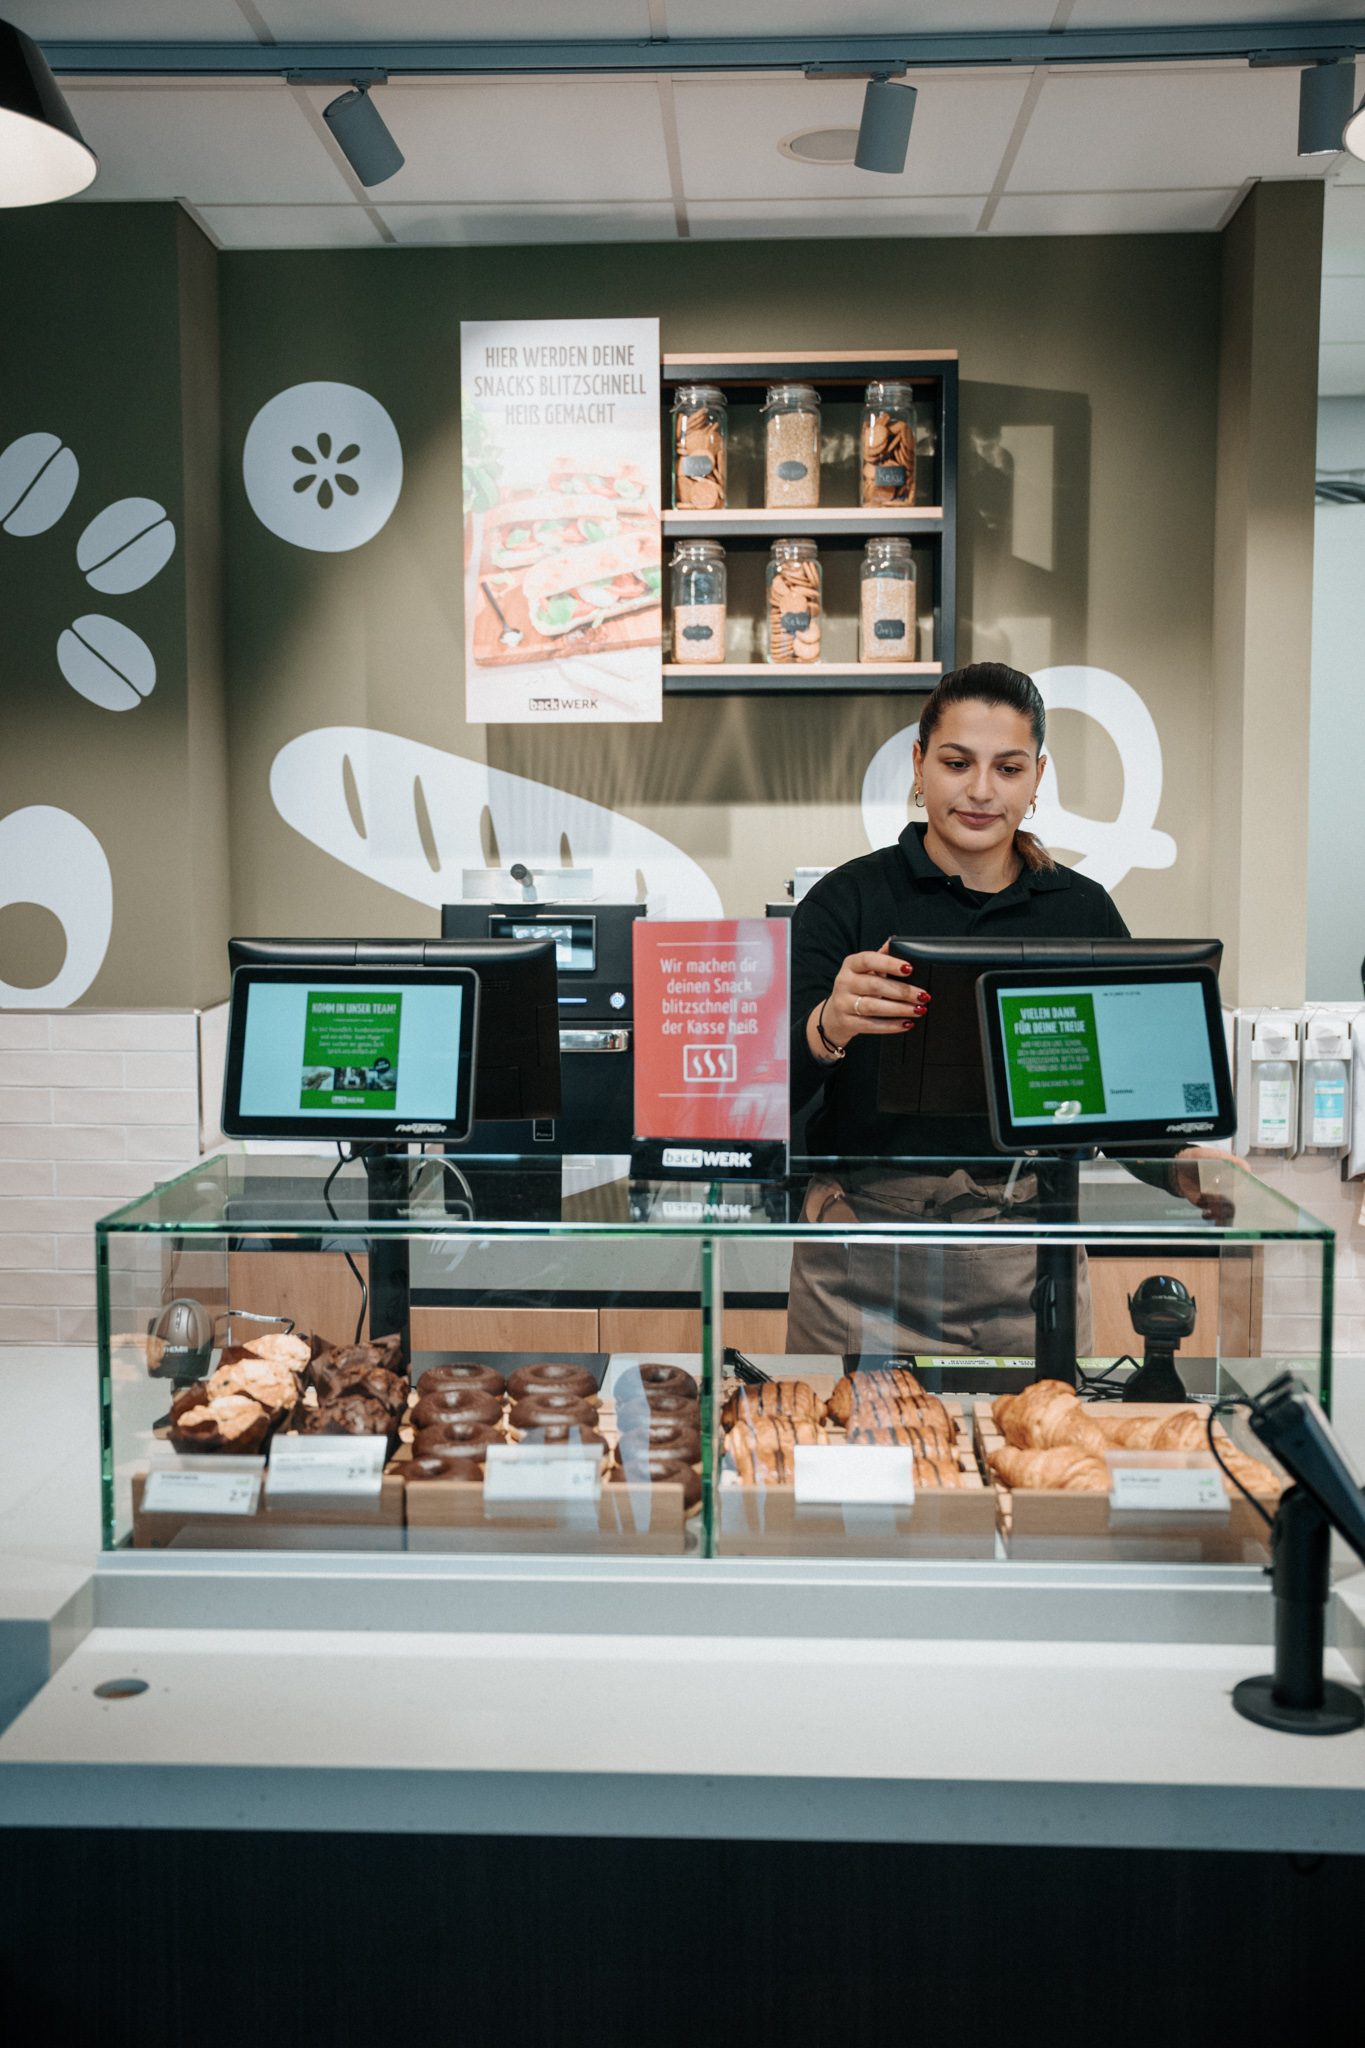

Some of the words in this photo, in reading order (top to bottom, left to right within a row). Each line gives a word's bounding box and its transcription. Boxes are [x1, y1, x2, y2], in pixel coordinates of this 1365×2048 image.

[486, 346, 518, 368] HIER
[523, 346, 587, 367] WERDEN
[593, 345, 635, 366] DEINE
[474, 375, 534, 397] SNACKS
[540, 374, 647, 396] BLITZSCHNELL
[545, 403, 616, 424] GEMACHT
[660, 958, 683, 974] Wir
[686, 957, 737, 974] machen
[739, 957, 758, 973] dir
[666, 978, 711, 994] deinen
[713, 977, 753, 994] Snack
[311, 1002, 336, 1014] KOMM
[335, 1002, 345, 1014] IN
[345, 1003, 371, 1014] UNSER
[372, 1003, 397, 1014] TEAM!
[661, 998, 738, 1015] blitzschnell
[740, 1001, 758, 1014] an
[1020, 1007, 1051, 1020] VIELEN
[1051, 1006, 1077, 1019] DANK
[661, 1019, 684, 1035] der
[686, 1019, 726, 1035] Kasse
[728, 1018, 759, 1035] heiß
[1013, 1019, 1032, 1035] FÜR
[1032, 1021, 1058, 1034] DEINE
[1058, 1020, 1086, 1033] TREUE
